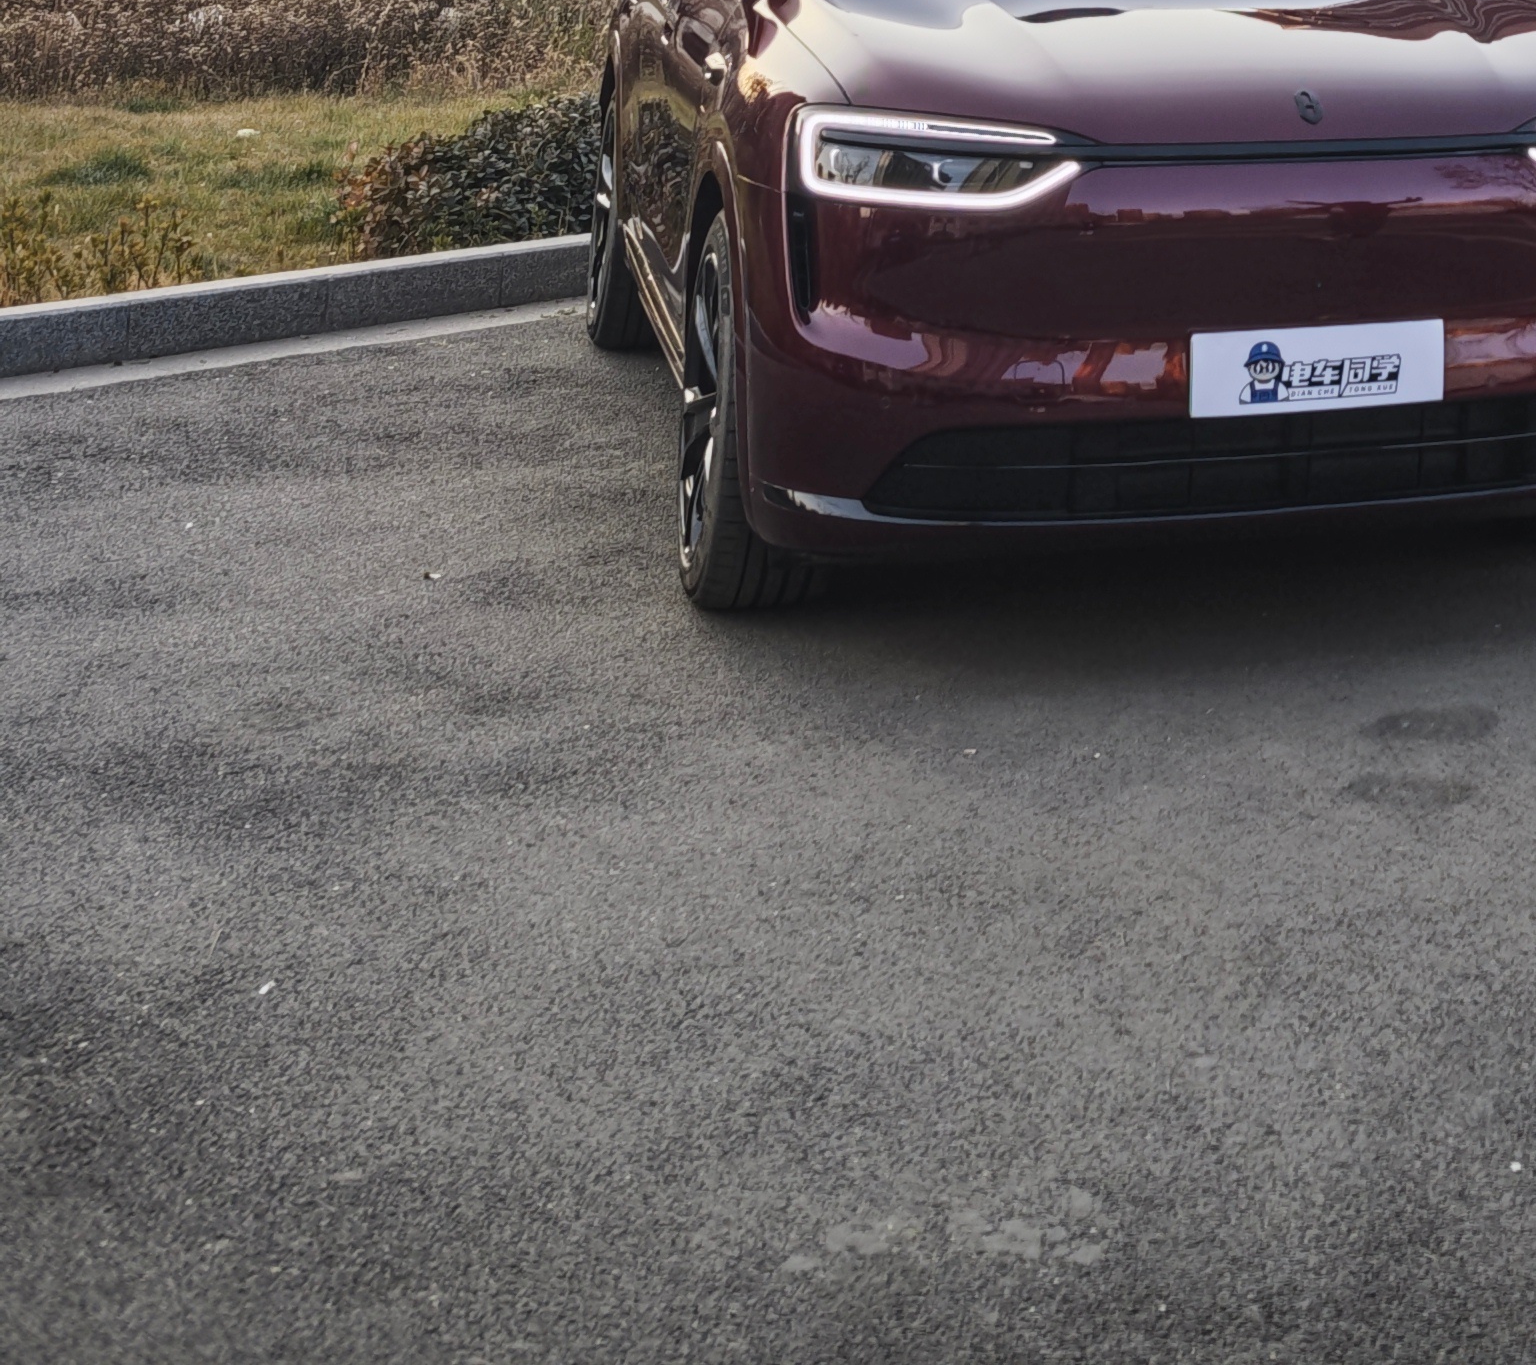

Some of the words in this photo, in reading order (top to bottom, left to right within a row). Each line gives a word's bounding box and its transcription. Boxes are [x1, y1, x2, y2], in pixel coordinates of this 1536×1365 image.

[1281, 354, 1400, 387] 电车同学
[1290, 389, 1314, 398] DIAN
